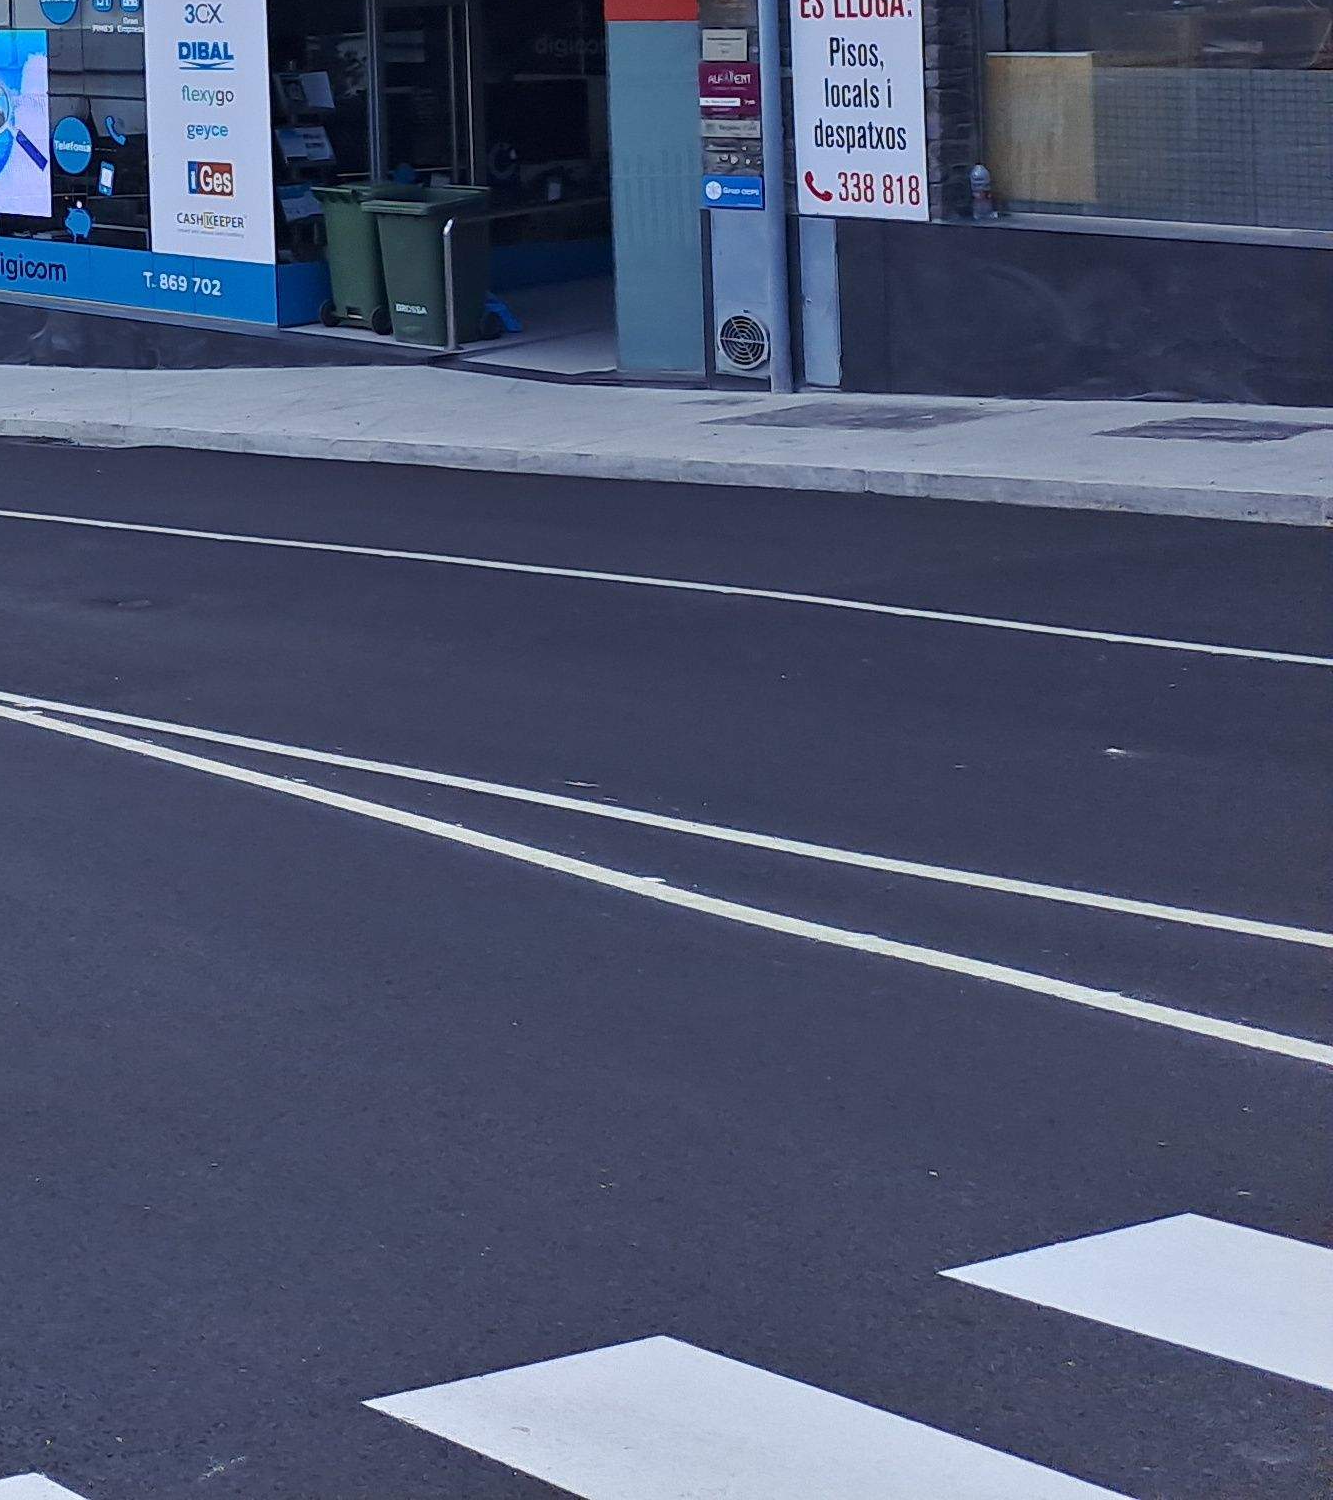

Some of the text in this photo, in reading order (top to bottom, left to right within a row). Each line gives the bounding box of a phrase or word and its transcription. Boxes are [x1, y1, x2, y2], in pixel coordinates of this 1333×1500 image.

[184, 3, 223, 24] 3CX
[177, 41, 235, 60] DIBAL
[829, 36, 884, 71] Pisos,
[181, 84, 235, 106] flexygo
[824, 77, 893, 109] locals i
[186, 123, 229, 140] geyce
[814, 117, 908, 155] despatxos
[838, 171, 921, 206] 338 818
[176, 211, 245, 229] CASHKEEPER
[159, 273, 188, 292] 869
[191, 276, 222, 296] 702
